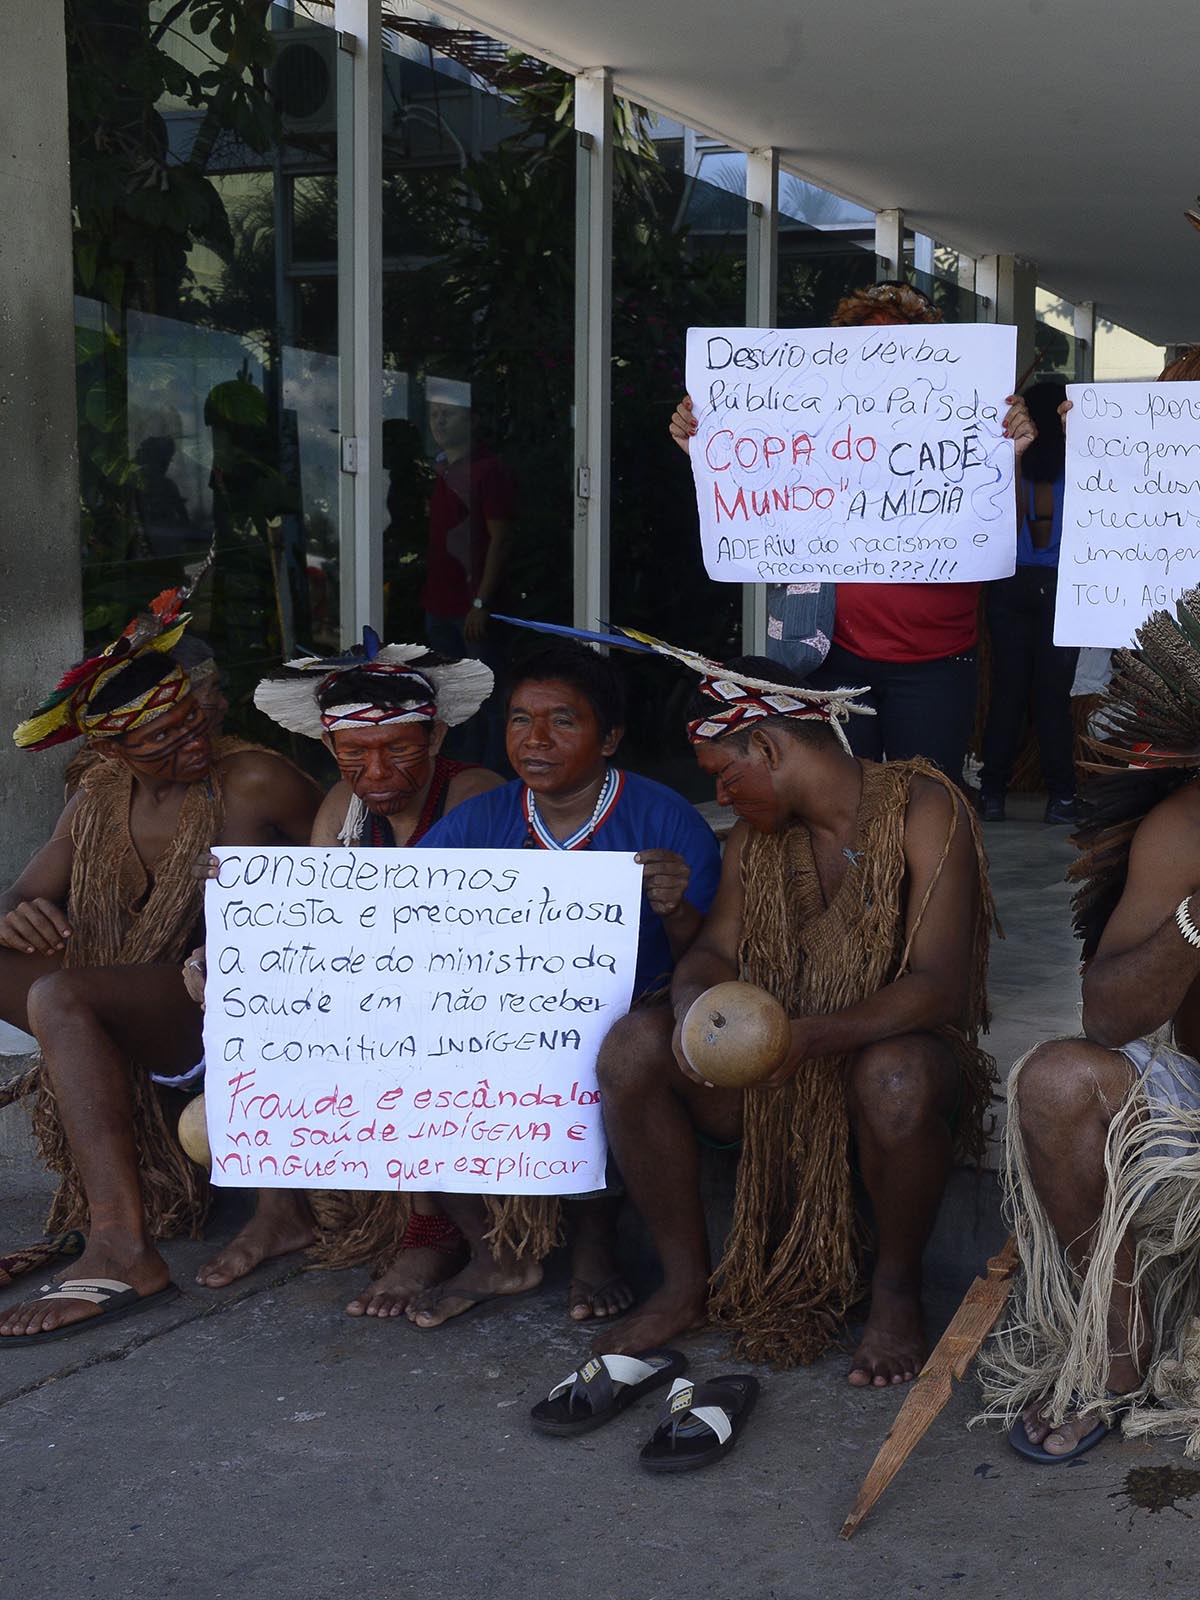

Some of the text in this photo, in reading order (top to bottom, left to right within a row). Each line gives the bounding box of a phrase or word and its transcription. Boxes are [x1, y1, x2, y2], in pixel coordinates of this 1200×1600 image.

[706, 337, 960, 370] Desvio de verba
[709, 379, 821, 413] Pública
[838, 393, 875, 414] no
[956, 389, 998, 423] da
[1080, 387, 1122, 419] Os
[706, 429, 815, 471] COPA
[888, 424, 982, 476] CADÊ
[1077, 470, 1119, 493] de
[847, 490, 866, 520] A
[808, 538, 839, 555] ao
[849, 535, 958, 553] racismo
[972, 533, 989, 547] e
[1071, 584, 1127, 606] TCU,
[220, 886, 626, 934] racista e preconceituosa
[218, 940, 617, 975] a atitude do ministro da
[359, 992, 402, 1013] em
[431, 986, 487, 1013] não
[499, 987, 607, 1013] receber
[223, 1036, 245, 1062] a
[427, 1028, 581, 1057] INDÍGENA
[228, 1068, 360, 1124] Fraude
[376, 1086, 404, 1111] e
[226, 1129, 272, 1147] na
[290, 1118, 399, 1148] saúde
[408, 1112, 551, 1142] INDÍGENA
[386, 1156, 445, 1190] quer
[453, 1150, 589, 1182] explicar
